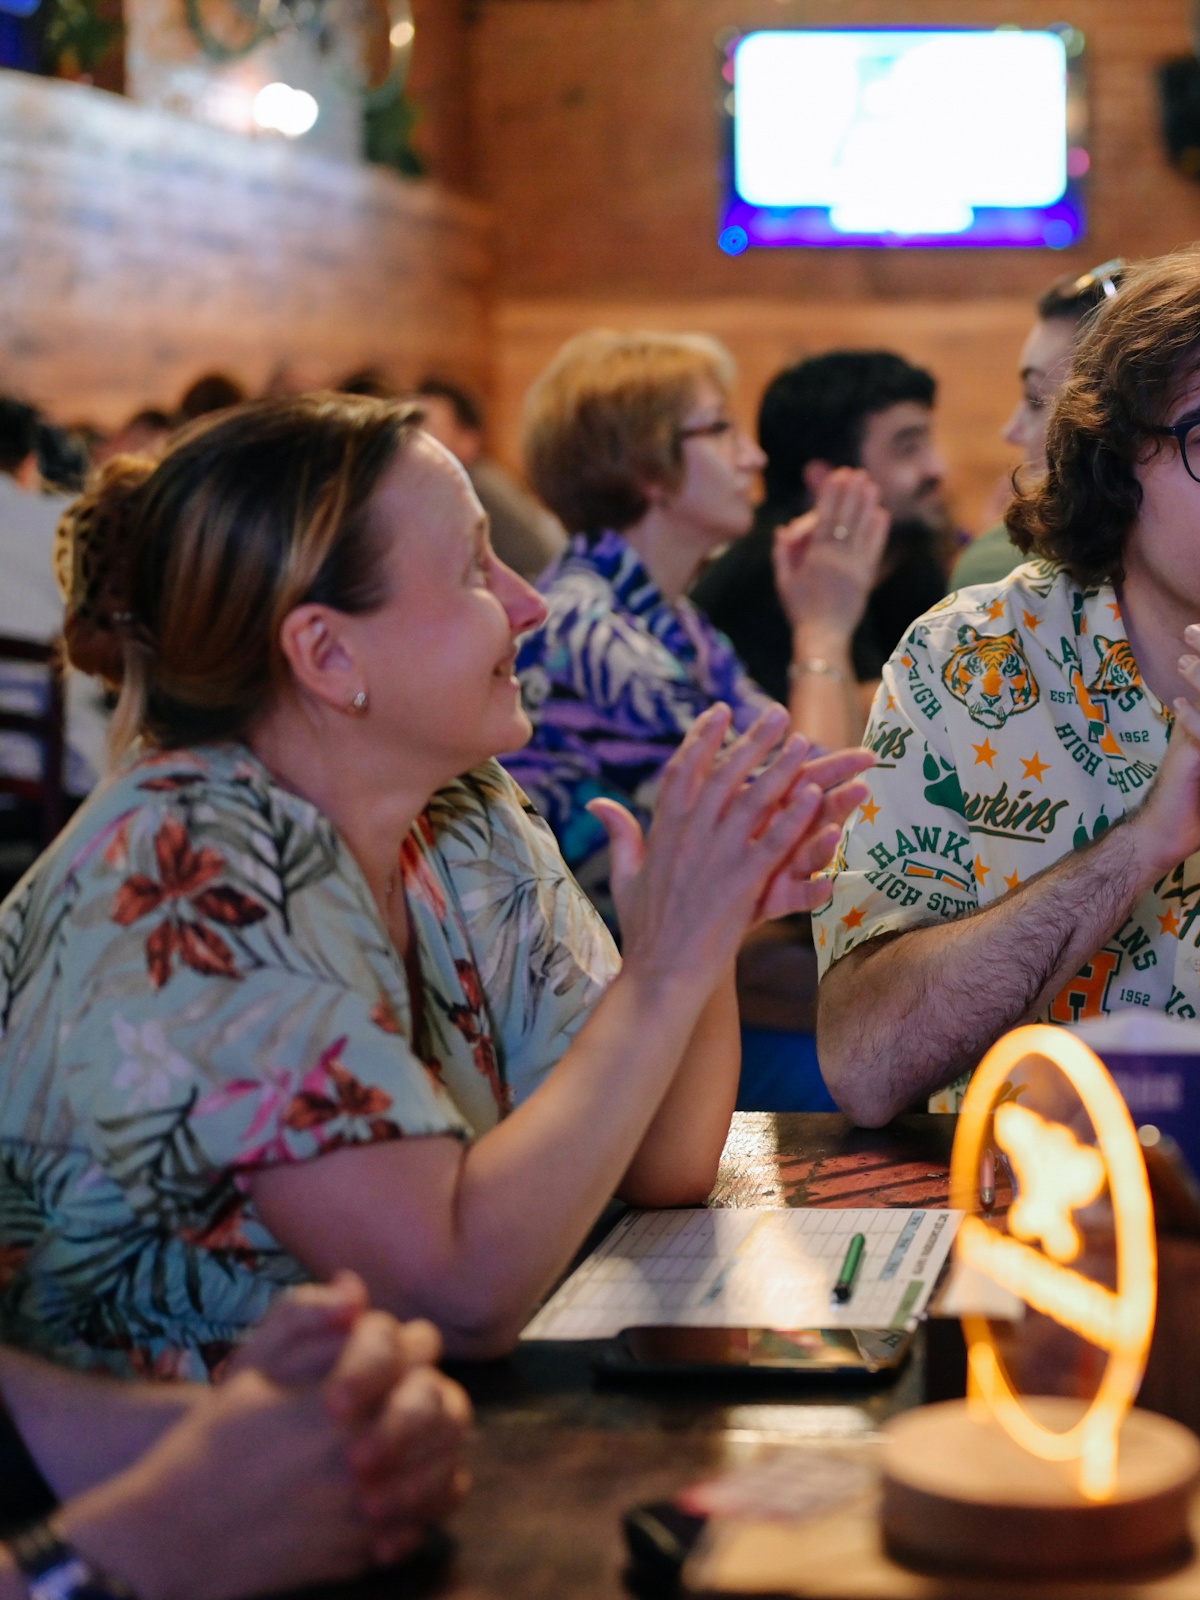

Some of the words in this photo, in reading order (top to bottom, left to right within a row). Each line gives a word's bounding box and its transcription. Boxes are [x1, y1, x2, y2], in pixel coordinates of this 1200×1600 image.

[1054, 722, 1104, 778] HIGH
[1119, 730, 1150, 743] 1952
[864, 870, 922, 907] HIGH
[1119, 987, 1151, 1007] 1952
